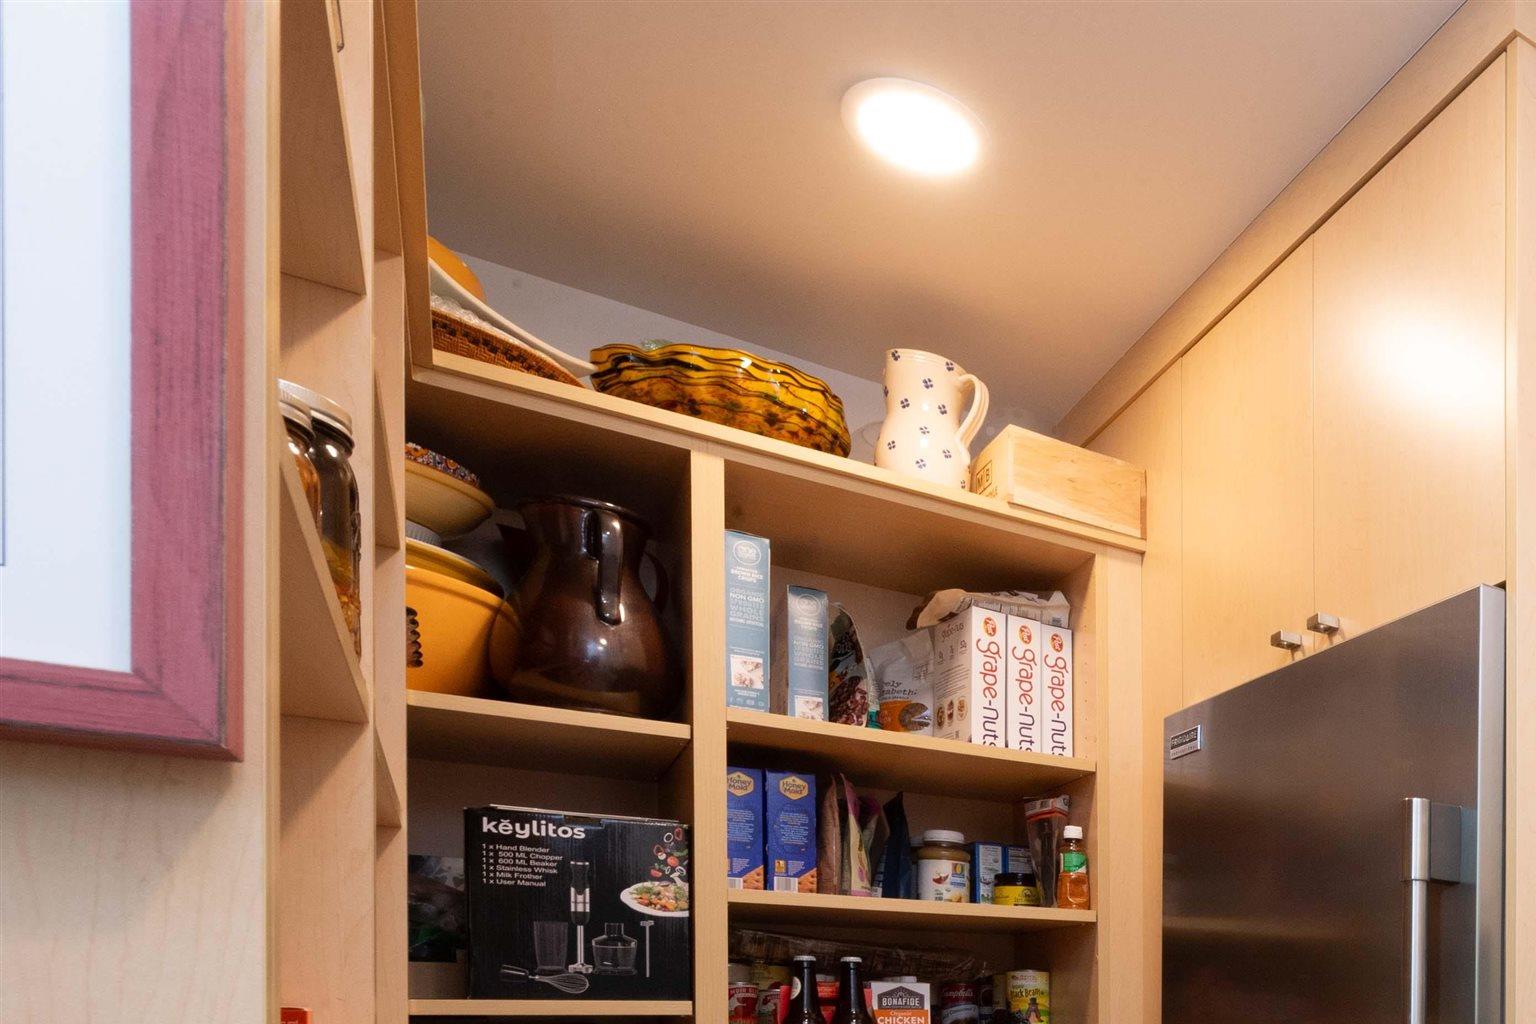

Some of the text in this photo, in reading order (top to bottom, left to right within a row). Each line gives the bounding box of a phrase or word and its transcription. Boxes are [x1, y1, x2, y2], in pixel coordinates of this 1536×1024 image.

[496, 865, 532, 873] Stainless
[882, 998, 920, 1006] BONAFIDE
[877, 1017, 925, 1024] CHICKEN
